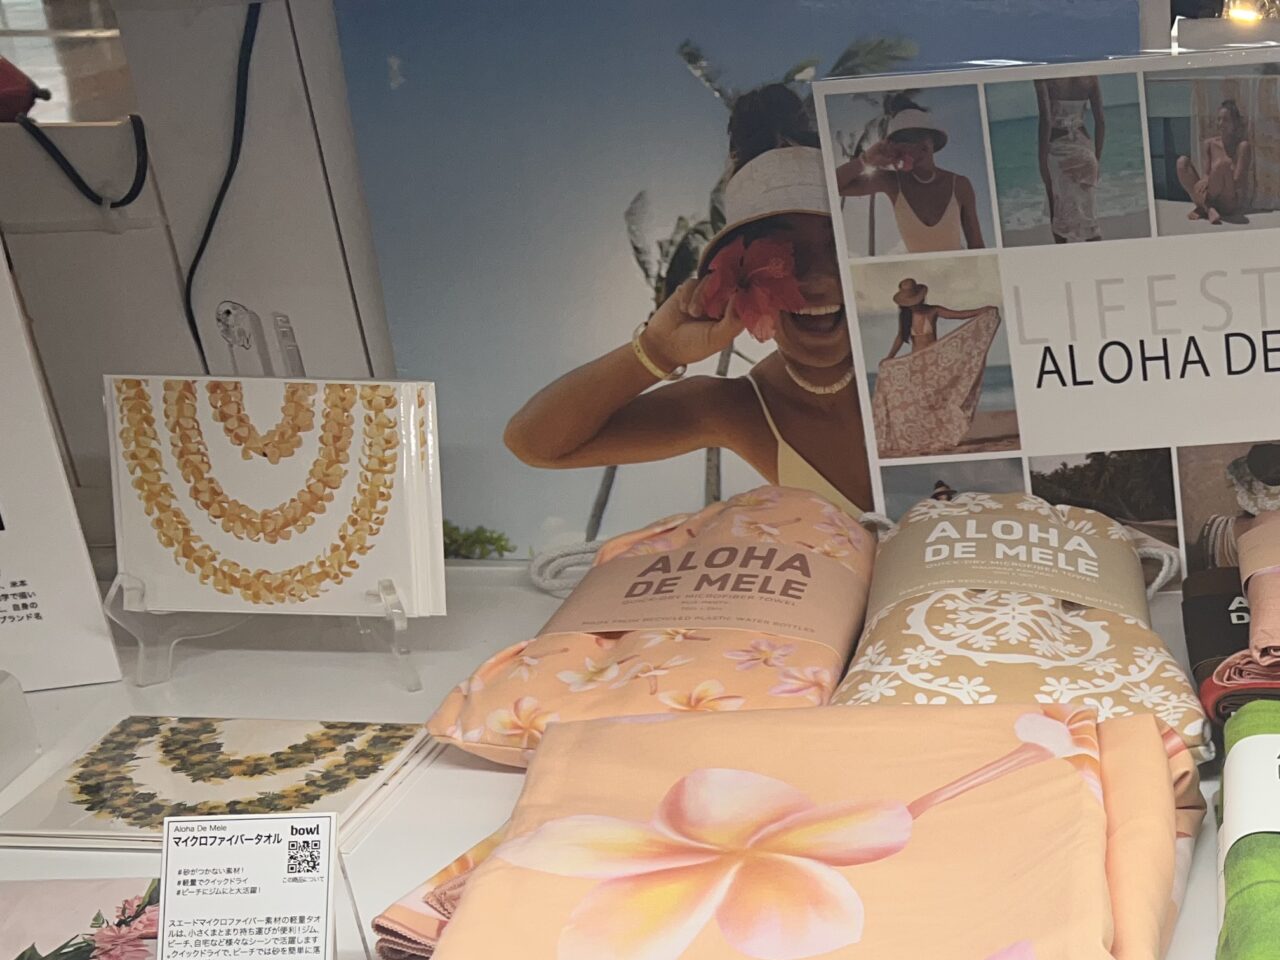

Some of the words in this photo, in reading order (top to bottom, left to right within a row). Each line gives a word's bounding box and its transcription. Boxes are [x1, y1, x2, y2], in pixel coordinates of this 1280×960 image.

[1036, 336, 1210, 388] ALOHA
[924, 519, 1098, 558] ALOHA
[637, 546, 812, 578] ALOHA
[924, 542, 977, 563] DE
[995, 543, 1099, 578] MELE
[624, 576, 682, 599] DE
[693, 573, 809, 600] MELE
[172, 833, 283, 848] マイクロファイバータオル
[290, 824, 320, 836] bowl
